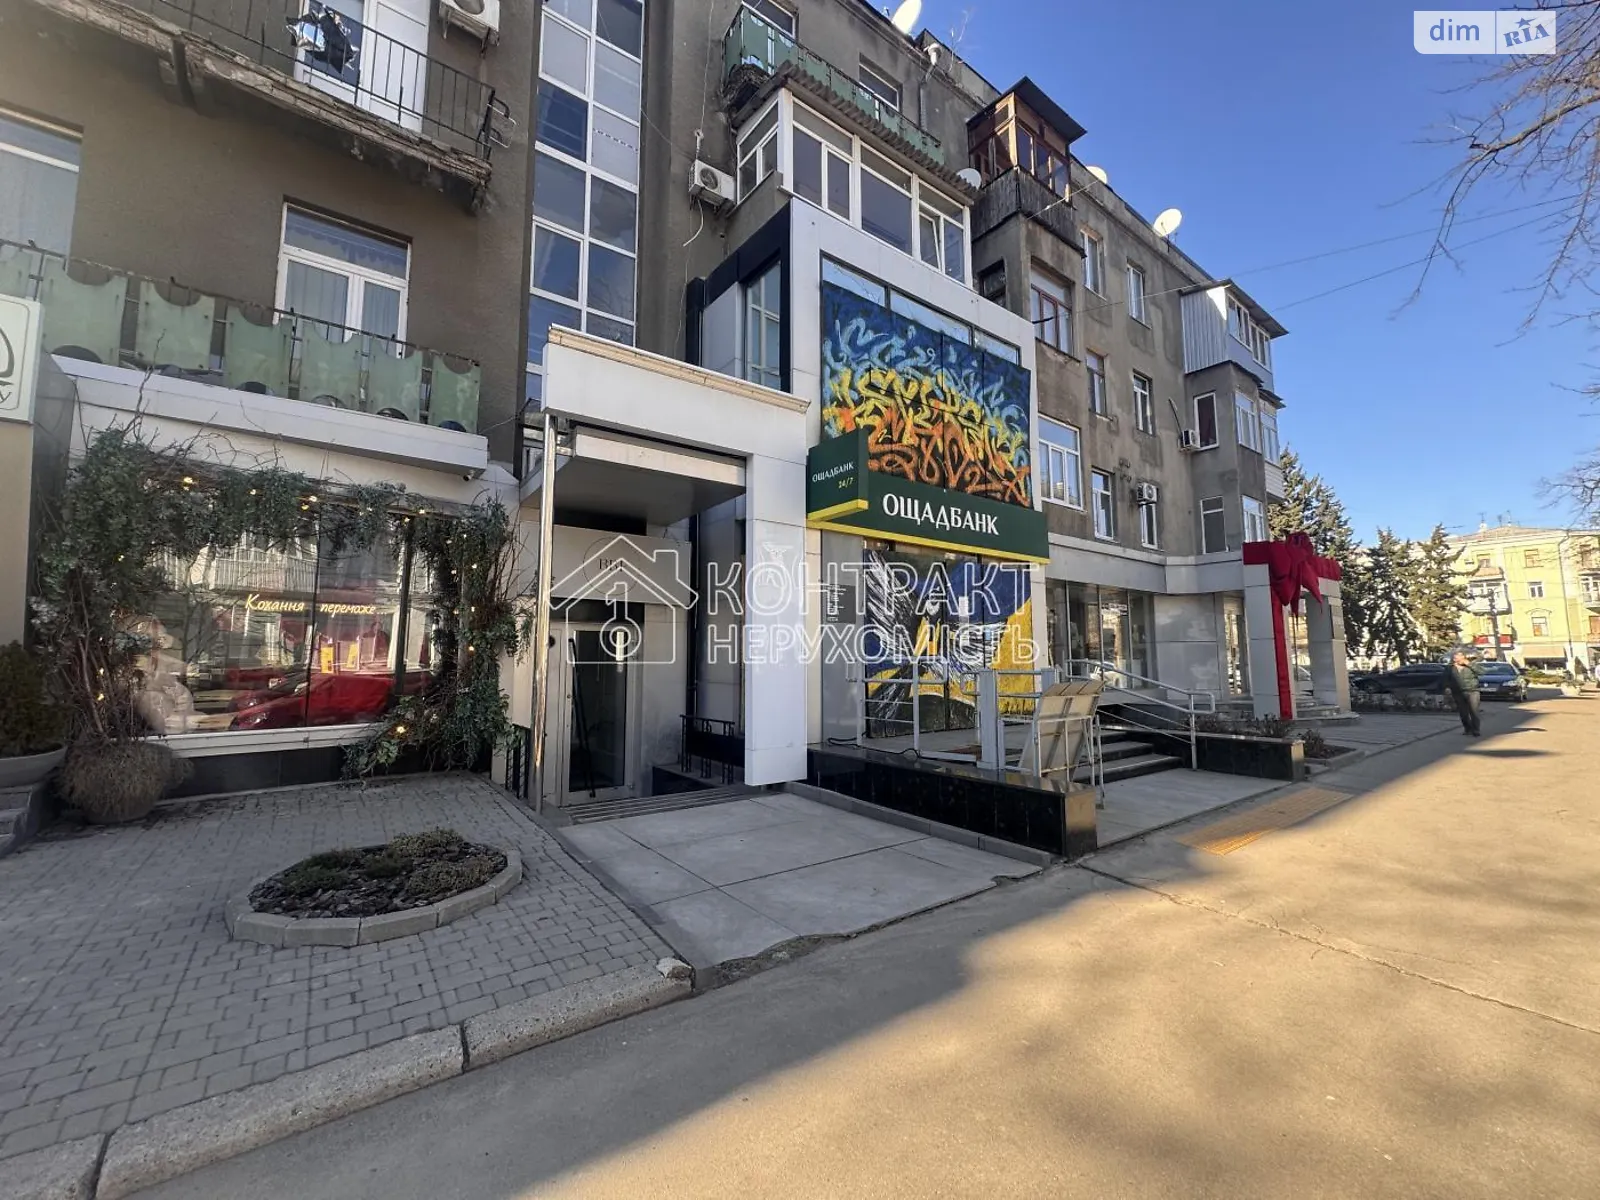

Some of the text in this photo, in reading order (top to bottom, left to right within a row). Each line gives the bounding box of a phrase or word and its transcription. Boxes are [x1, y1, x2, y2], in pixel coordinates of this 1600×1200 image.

[812, 461, 854, 483] ОЩАДБАНК
[838, 477, 854, 489] 24/7
[882, 493, 999, 535] ОЩАДБАНК
[244, 594, 305, 612] Кохання
